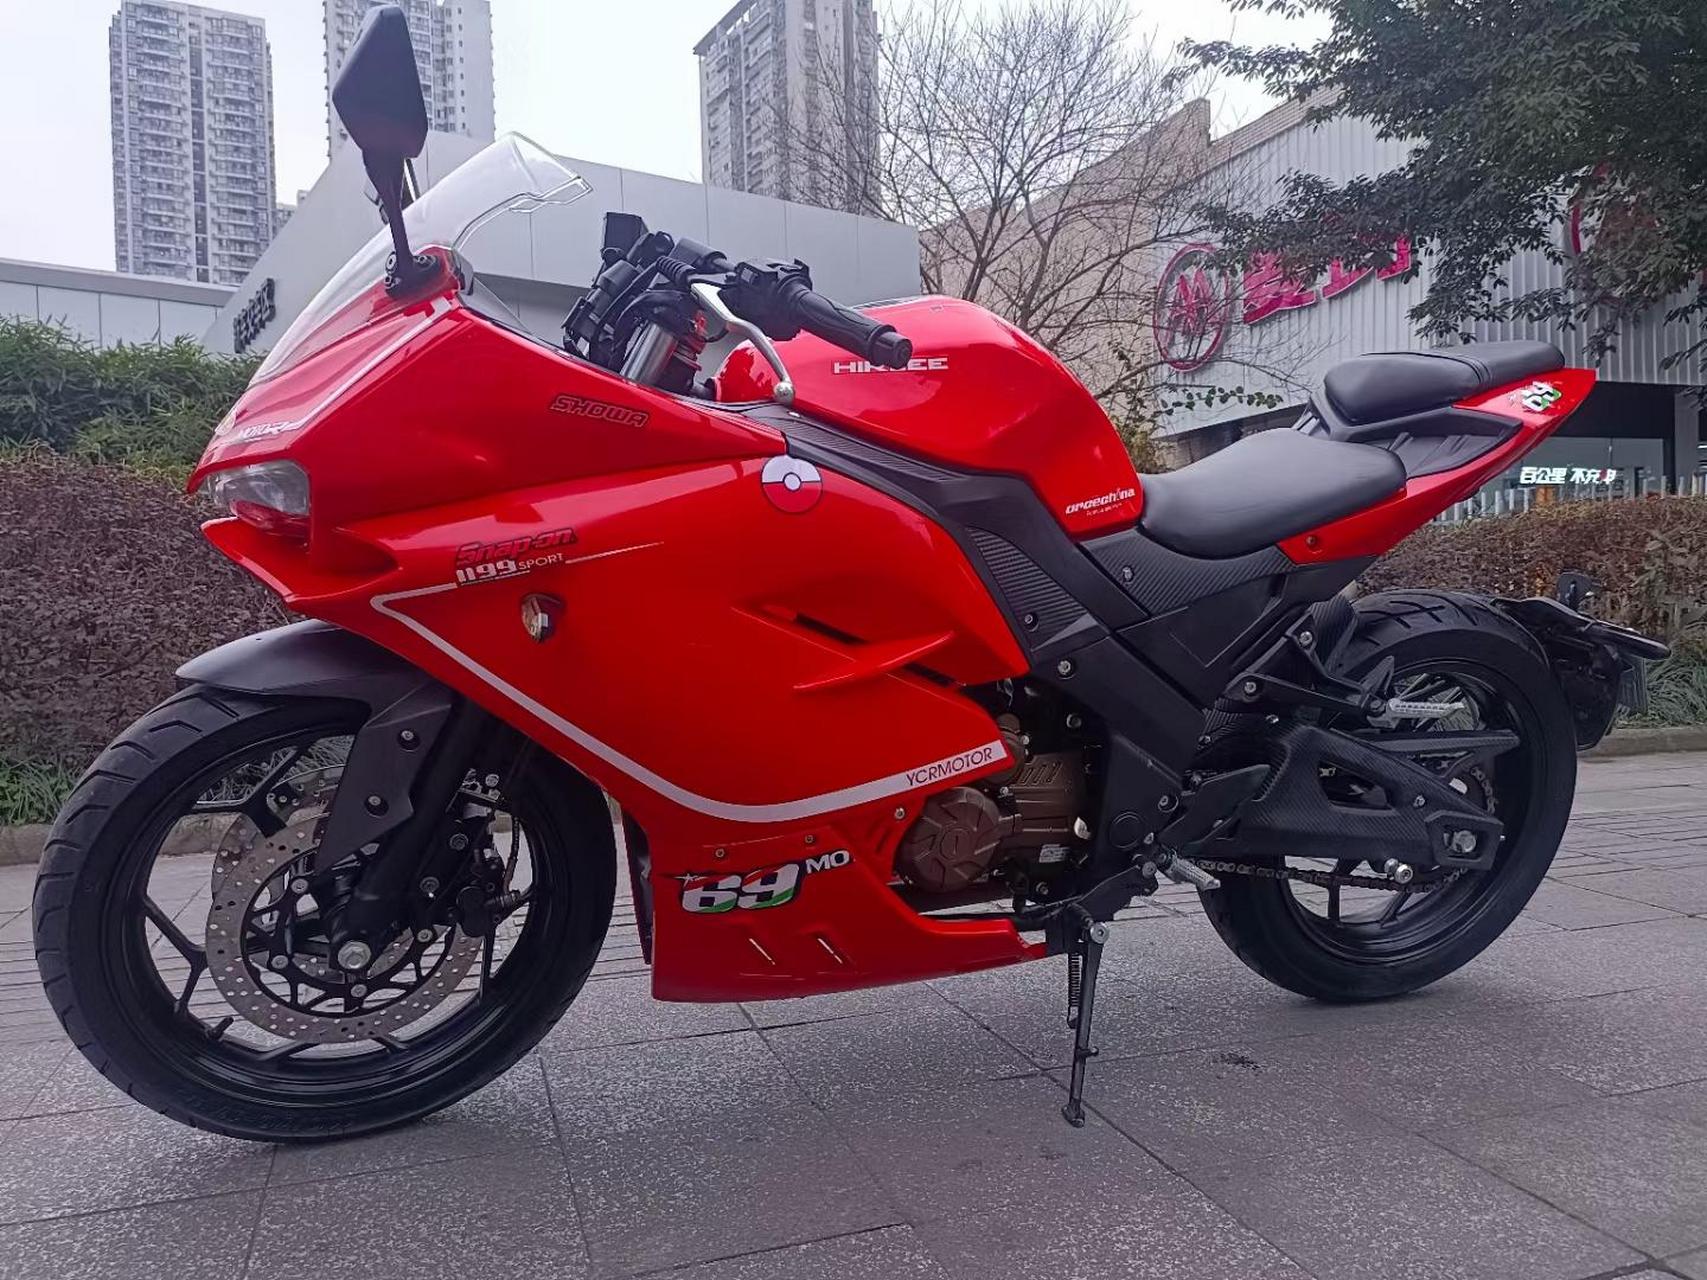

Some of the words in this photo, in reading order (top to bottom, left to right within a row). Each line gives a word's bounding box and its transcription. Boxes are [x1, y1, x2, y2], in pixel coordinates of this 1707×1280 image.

[833, 357, 949, 374] HIEE
[549, 395, 648, 428] SHOWA
[1519, 466, 1568, 485] 百公里
[456, 528, 577, 566] Snap-on
[518, 552, 564, 571] SPORT
[906, 747, 993, 787] YCRMOTOR
[682, 863, 800, 914] 69
[805, 850, 851, 875] MO
